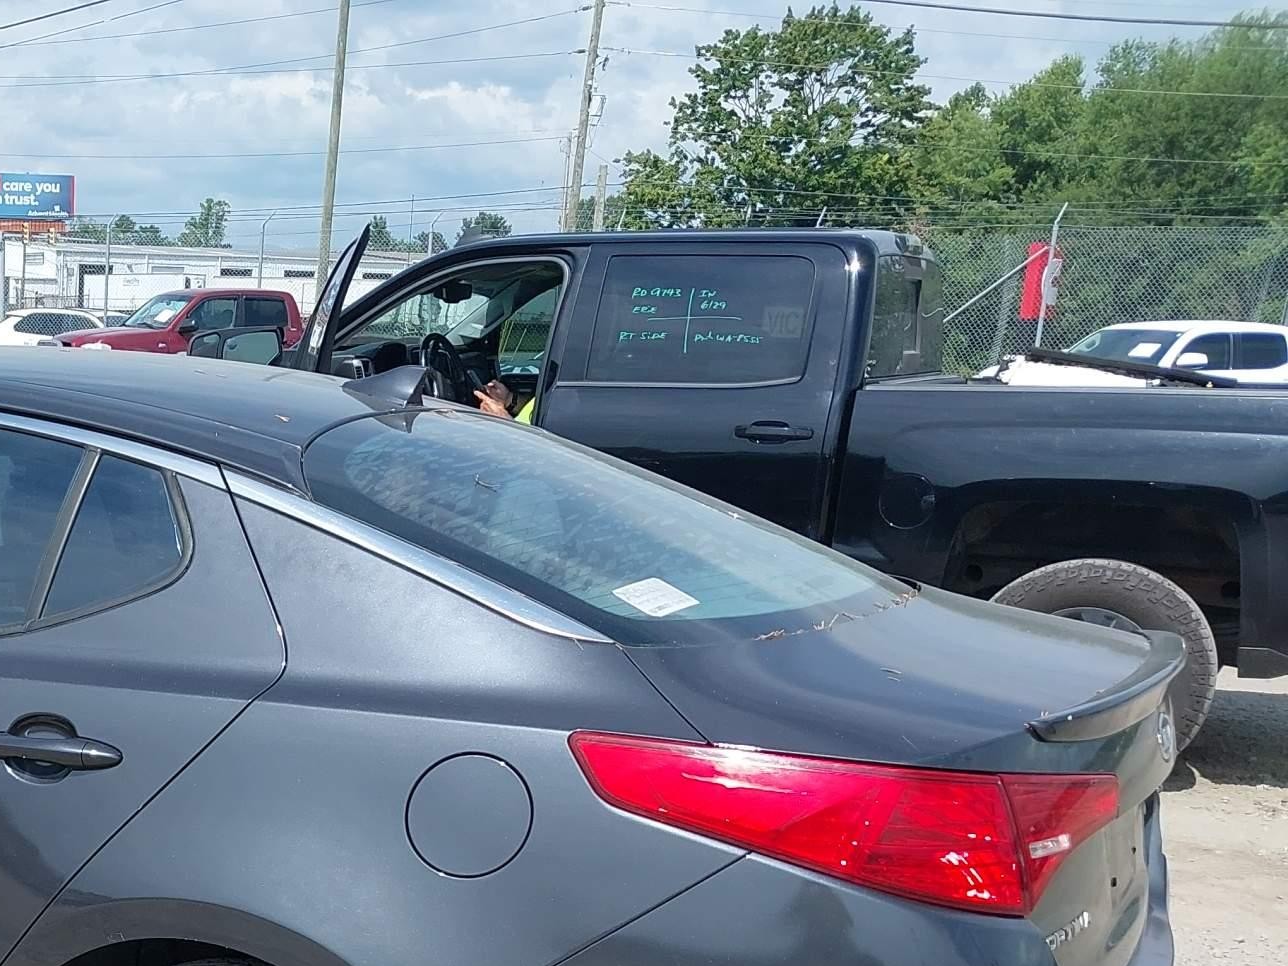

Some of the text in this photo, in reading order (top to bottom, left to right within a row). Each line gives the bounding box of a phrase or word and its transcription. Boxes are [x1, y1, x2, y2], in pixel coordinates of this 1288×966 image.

[2, 182, 33, 192] care
[35, 182, 61, 195] you
[4, 193, 40, 206] trust.
